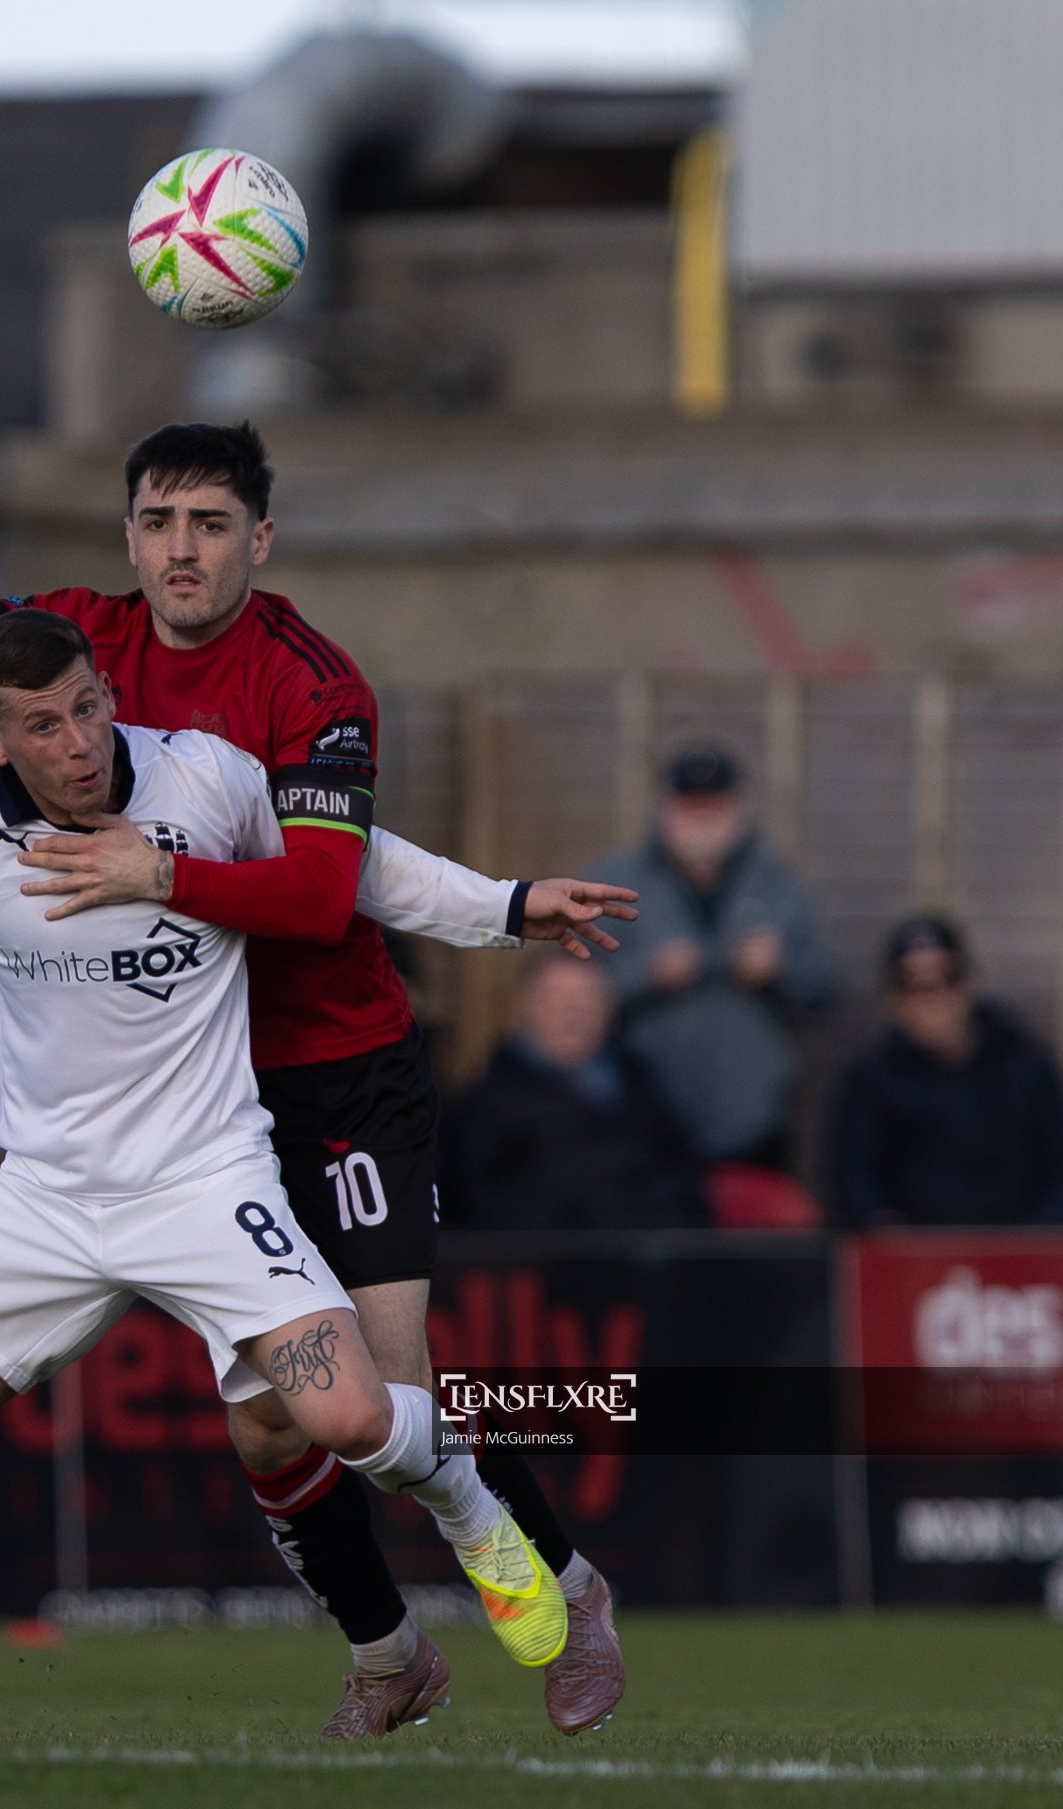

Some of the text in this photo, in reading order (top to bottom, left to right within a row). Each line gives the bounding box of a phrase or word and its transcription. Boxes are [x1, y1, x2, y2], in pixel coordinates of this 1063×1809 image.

[342, 726, 360, 738] sse
[277, 787, 350, 817] APTAIN
[0, 943, 202, 983] WhiteBOX
[324, 1151, 388, 1231] 10
[234, 1200, 294, 1257] 8
